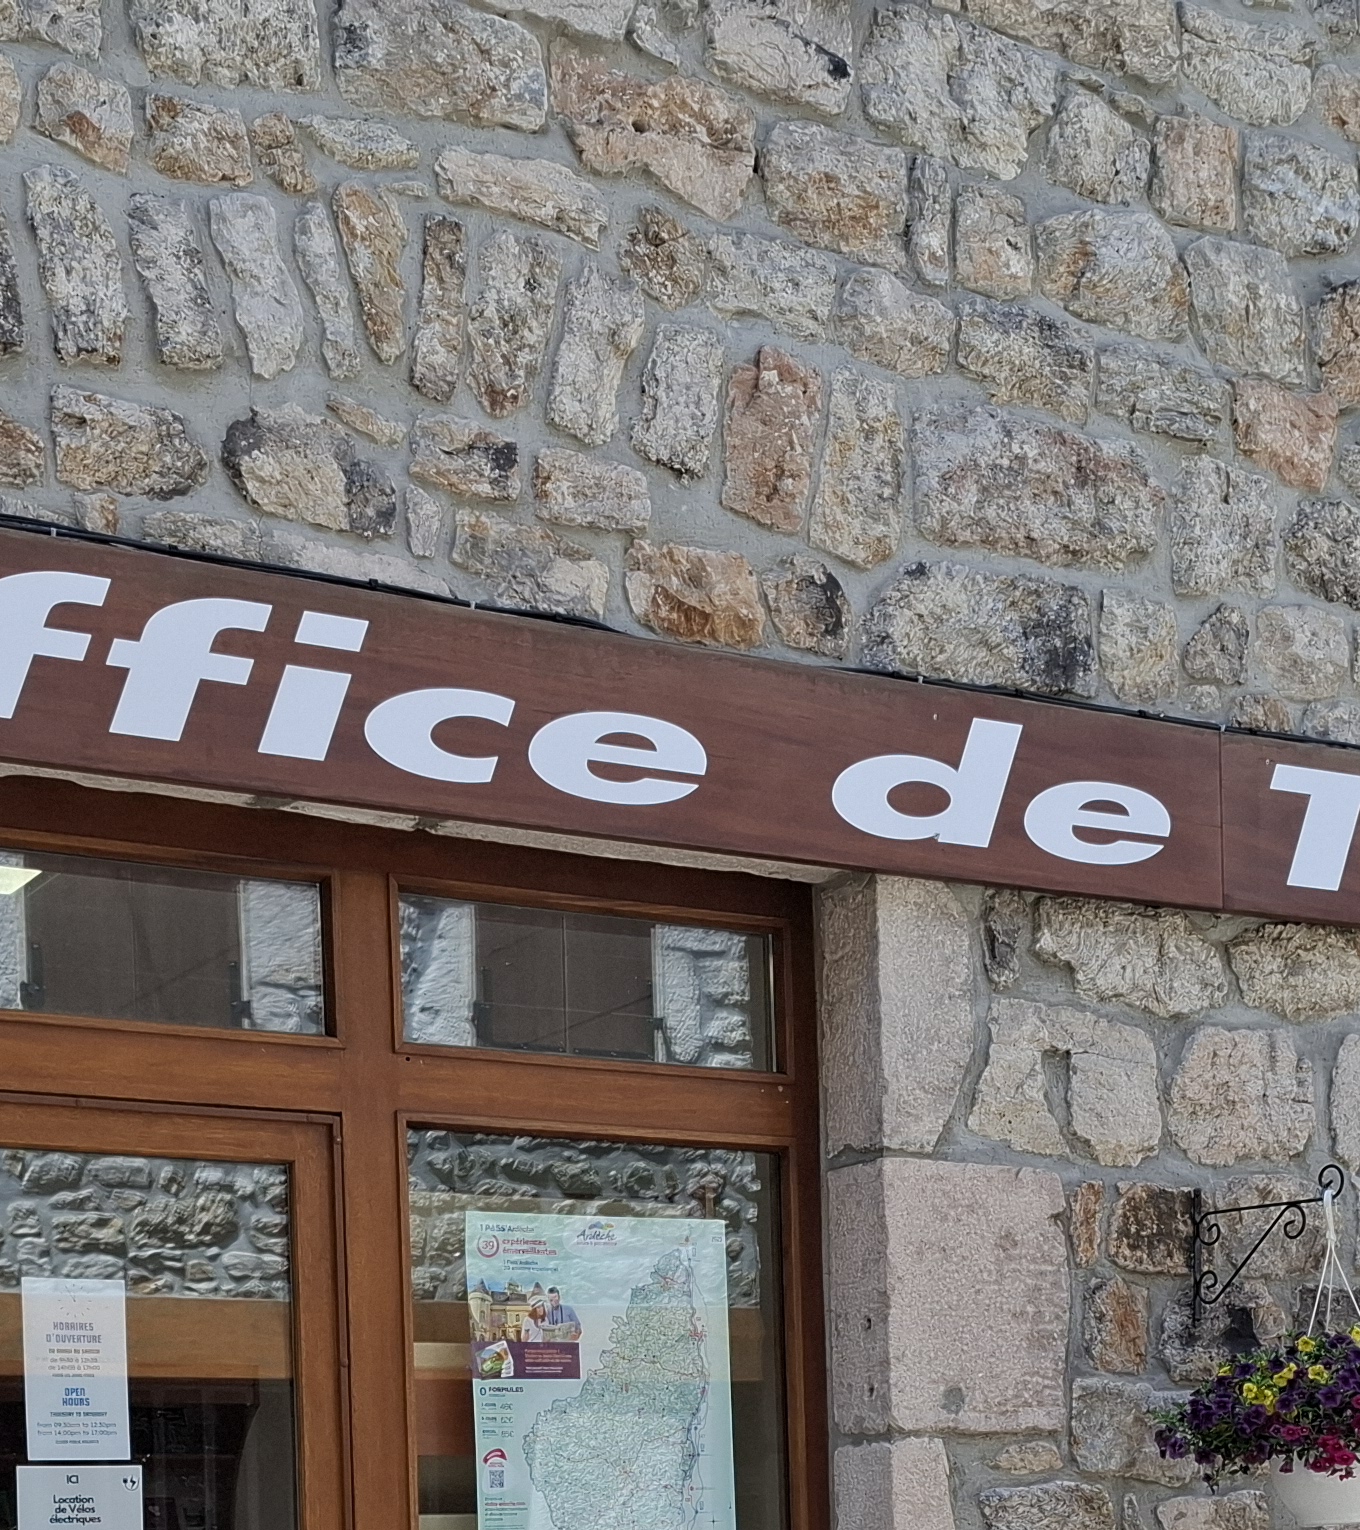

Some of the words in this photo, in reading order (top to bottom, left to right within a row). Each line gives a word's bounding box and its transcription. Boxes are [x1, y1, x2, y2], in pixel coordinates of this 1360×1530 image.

[831, 717, 1171, 865] de
[481, 1240, 495, 1250] 39
[53, 1321, 94, 1331] HORAIRES
[46, 1333, 102, 1343] D'OUVERTURE
[64, 1388, 85, 1396] OPEN
[62, 1397, 90, 1407] HOURS
[66, 1475, 79, 1484] ICI
[53, 1494, 94, 1504] Location
[55, 1504, 66, 1514] de
[68, 1504, 95, 1513] Vélos
[49, 1514, 101, 1526] électriques
